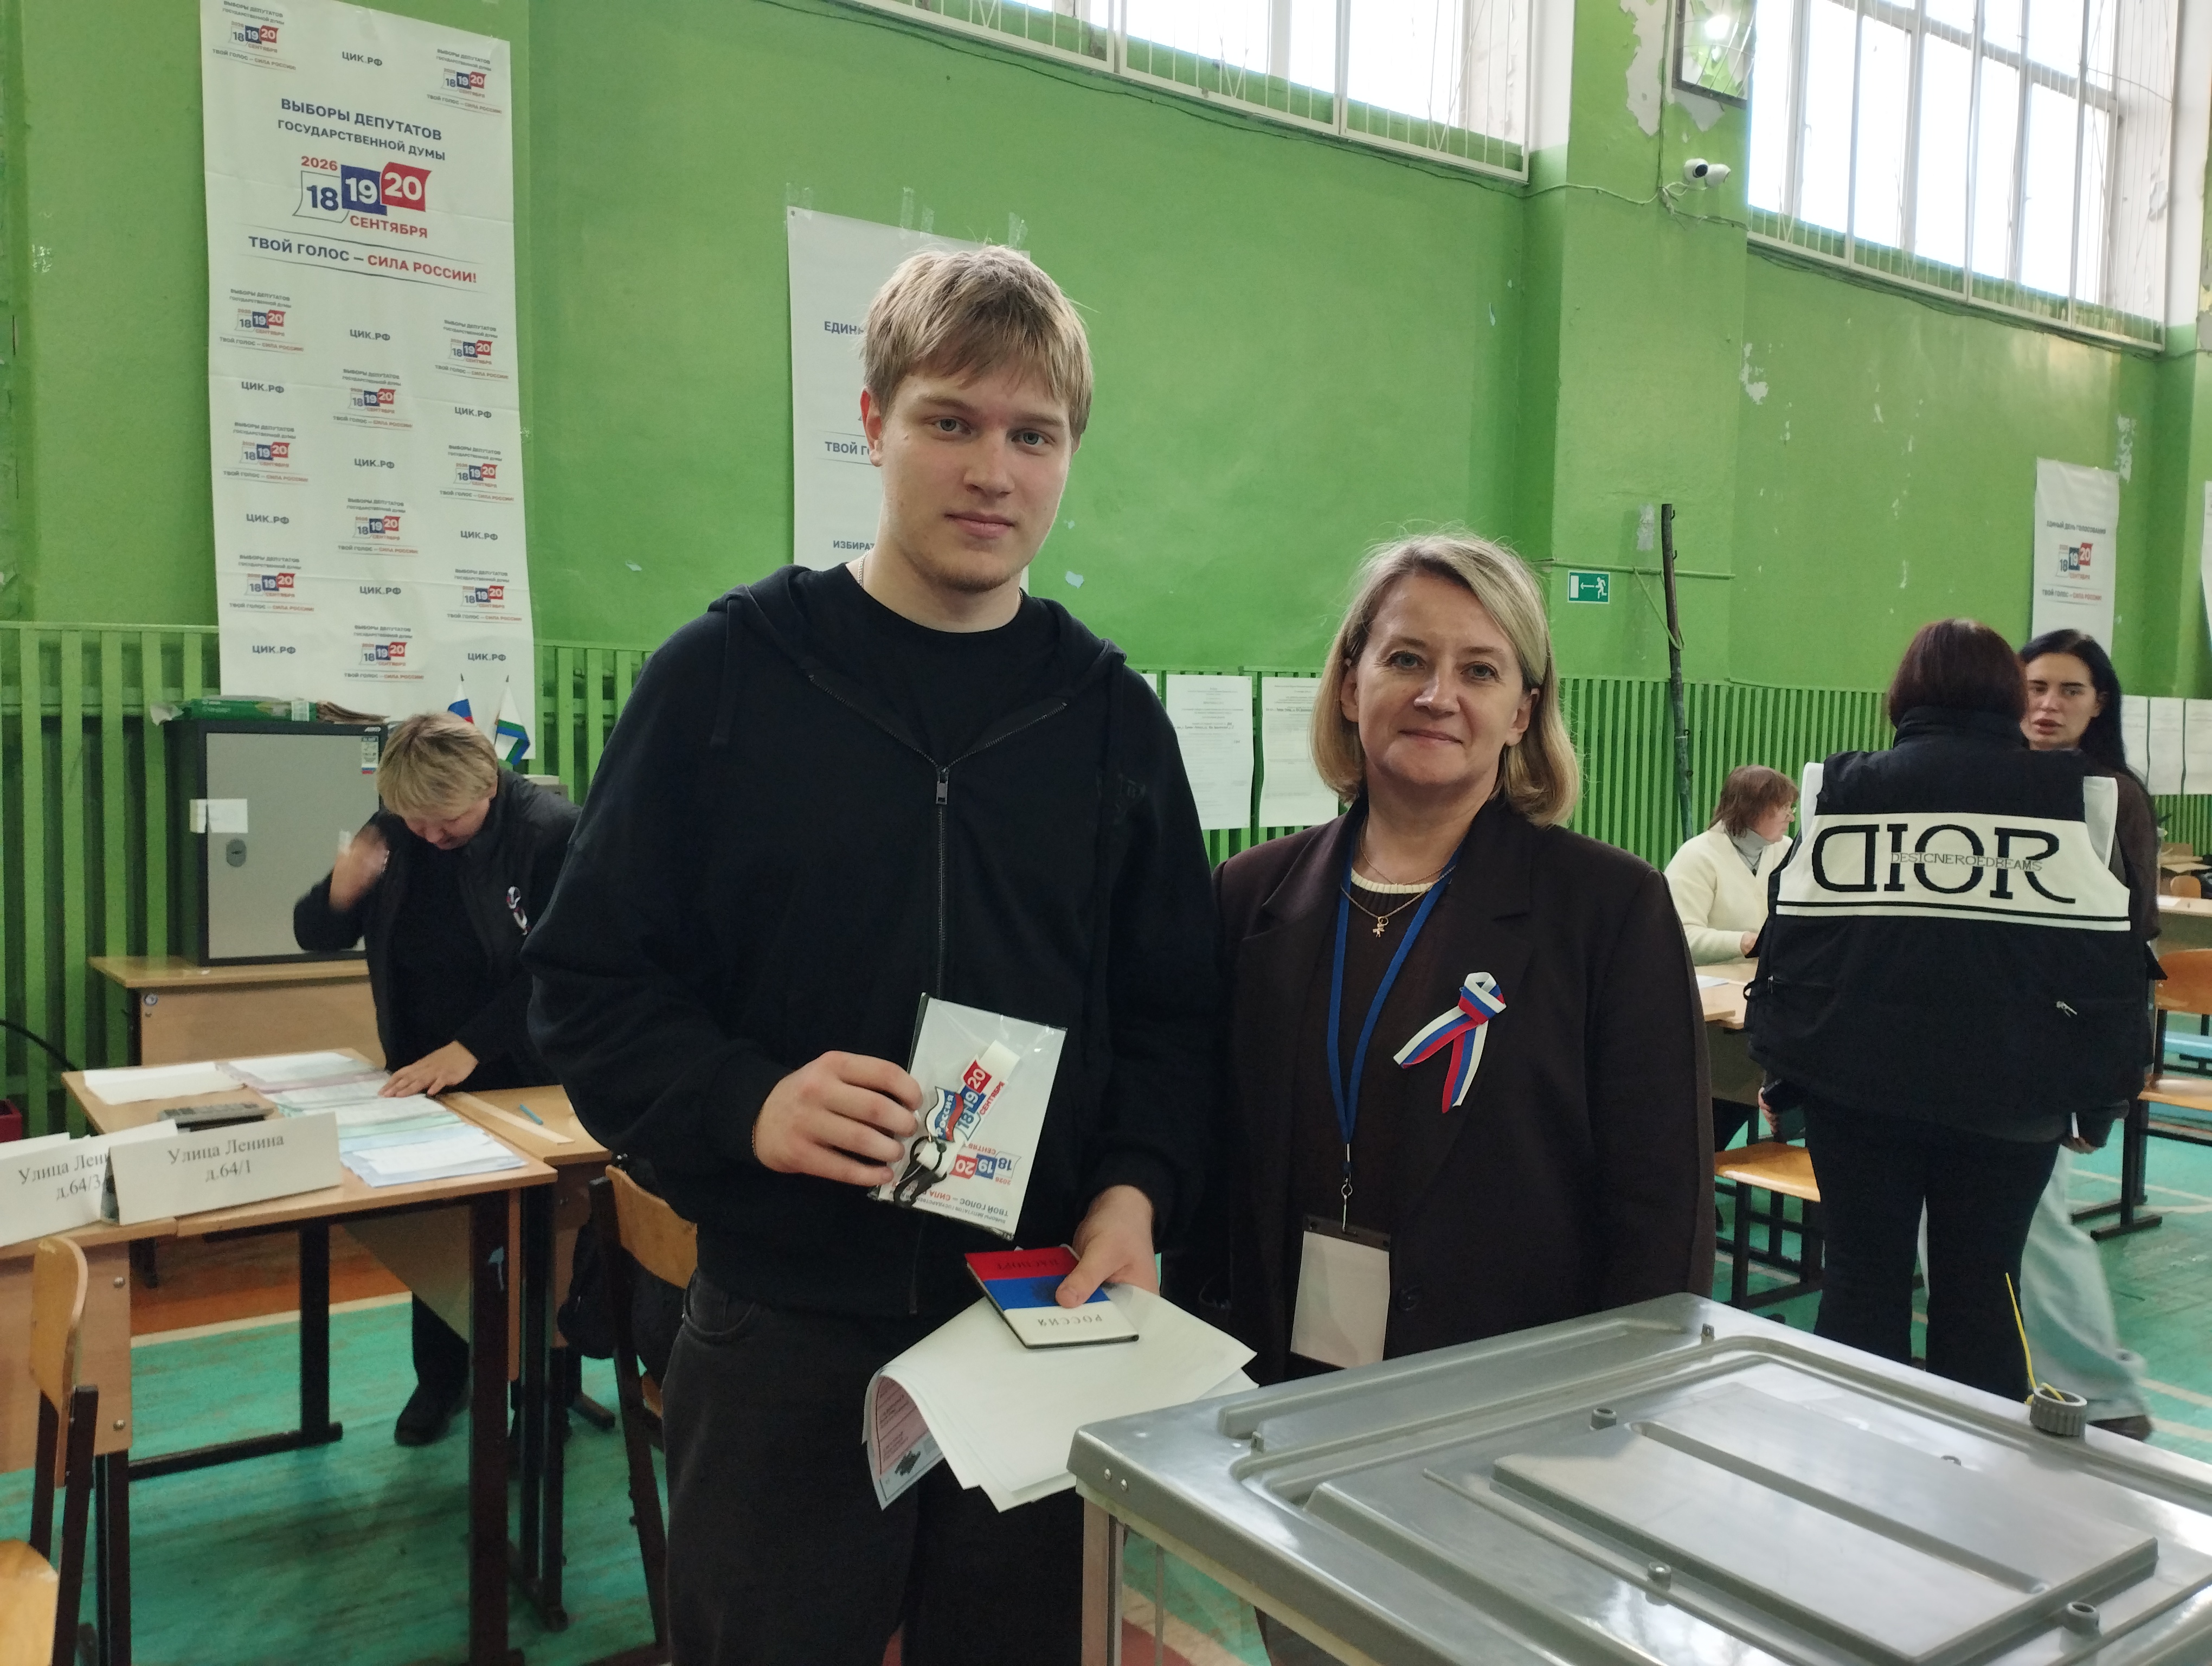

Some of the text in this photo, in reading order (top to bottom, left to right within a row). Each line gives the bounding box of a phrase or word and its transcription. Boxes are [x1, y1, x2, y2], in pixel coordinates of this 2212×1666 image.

[224, 1, 248, 10] ВЫБОРЫ
[233, 29, 275, 42] 18 19 20
[342, 51, 383, 67] ЦИК.РФ
[446, 75, 483, 87] 18 19 20
[281, 98, 442, 141] ВЫБОРЫ ДЕПУТАТОВ
[278, 119, 445, 161] ГОСУДАРСТВЕННОЙ ДУМЫ
[301, 156, 338, 171] 2026
[307, 172, 422, 211] 18 19 20
[350, 215, 428, 239] СЕНТЯБРЯ
[248, 235, 292, 254] ТВОЙ
[297, 243, 350, 262] ГОЛОС
[368, 254, 409, 272] СИЛА
[414, 262, 477, 283] РОССИИ!
[240, 313, 282, 328] 18 19 20
[350, 329, 390, 342] ЦИК.РФ
[452, 343, 490, 357] 18 19 20
[241, 381, 284, 394] ЦИК.РФ
[353, 392, 393, 407] 18 19 20
[454, 406, 492, 419] ЦИК.РФ
[245, 445, 287, 460] 18 19 20
[825, 441, 857, 455] ТВОЙ
[354, 458, 395, 470] ЦИК.РФ
[458, 466, 494, 480] 18 19 20
[246, 513, 290, 525] ЦИК.РФ
[358, 519, 397, 535] 18 19 20
[460, 530, 498, 541] ЦИК.РФ
[2060, 547, 2090, 572] 18 19 20
[250, 576, 292, 592] 18 19 20
[359, 585, 401, 595] ЦИК.РФ
[477, 591, 487, 600] 19
[490, 588, 502, 597] 20
[252, 644, 296, 655] ЦИК.РФ
[364, 645, 404, 662] 18 19 20
[467, 652, 506, 663] ЦИК.РФ
[957, 1069, 986, 1129] 18 19 20
[980, 1081, 1005, 1116] СЕНТЯБРЯ
[168, 1136, 284, 1164] Улица Ленина
[968, 1144, 996, 1155] СЕНТЯБ
[18, 1162, 69, 1184] Улица
[205, 1159, 250, 1182] д.64/1
[955, 1157, 1012, 1175] 18 19 20
[929, 1190, 951, 1201] СИЛА
[960, 1198, 986, 1211] ГОЛОС
[987, 1204, 1008, 1216] ТВОЙ
[1037, 1314, 1103, 1327] РОССИЯ
